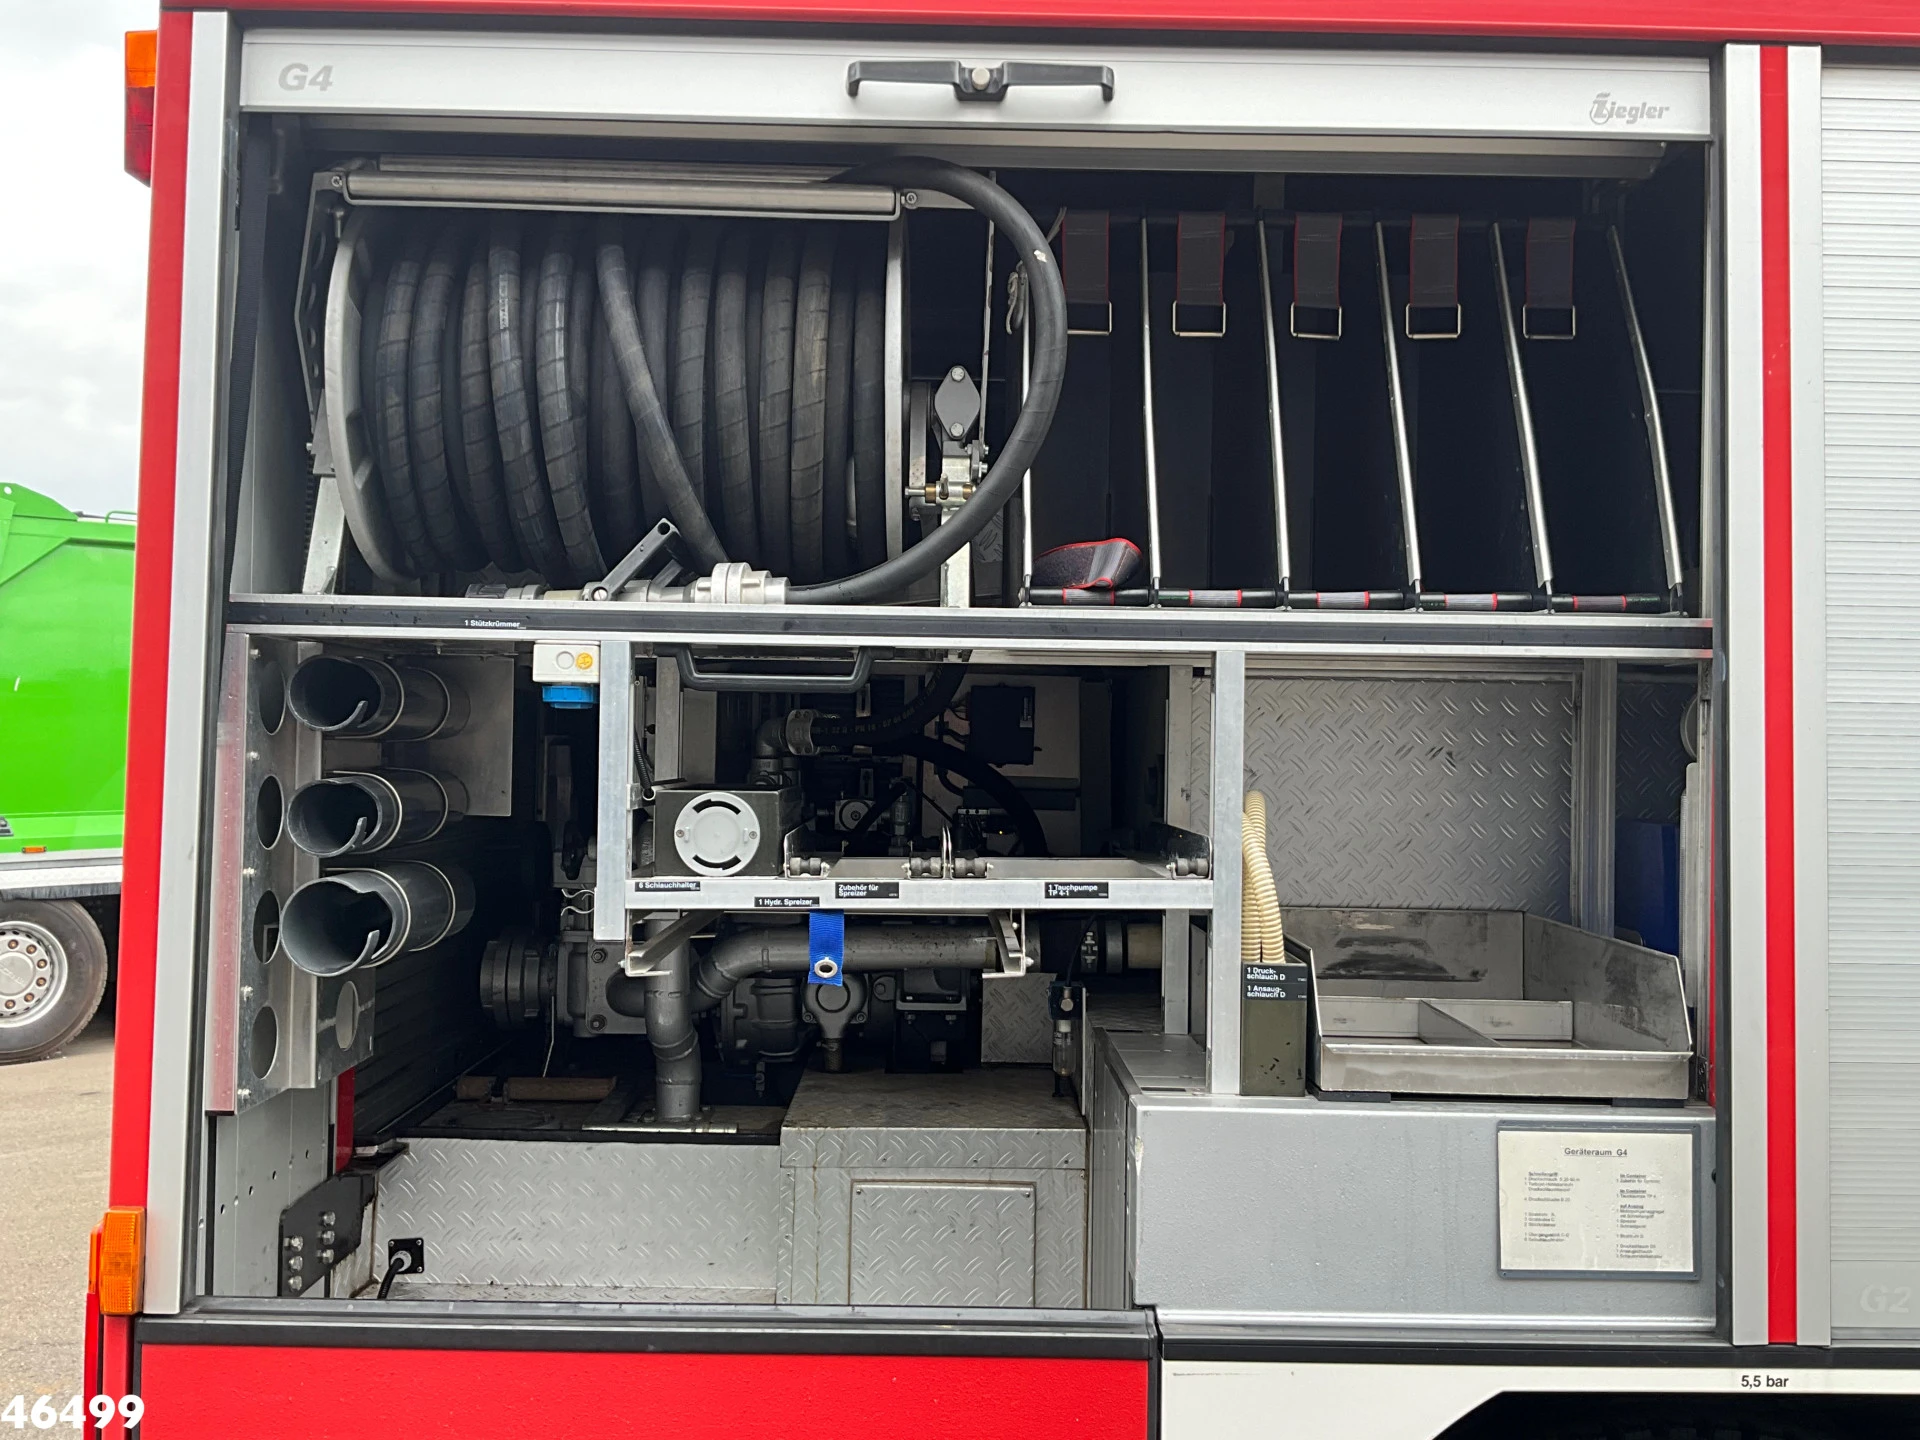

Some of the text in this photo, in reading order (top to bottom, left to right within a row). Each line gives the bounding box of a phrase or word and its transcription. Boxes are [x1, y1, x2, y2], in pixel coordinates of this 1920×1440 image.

[278, 62, 334, 92] G4
[1589, 92, 1670, 125] Ziegler
[470, 619, 521, 628] Stützkrümmer
[1053, 884, 1098, 892] Tauchpumpe
[838, 890, 867, 898] Spreizer
[764, 898, 783, 907] Hydr.
[783, 898, 813, 907] Spreizer
[1246, 972, 1286, 981] schlauch D
[1252, 985, 1282, 993] Ansaug-
[1564, 1147, 1629, 1157] Geräteraum G4
[1860, 1284, 1911, 1313] G2
[1741, 1374, 1789, 1389] 5,5 bar
